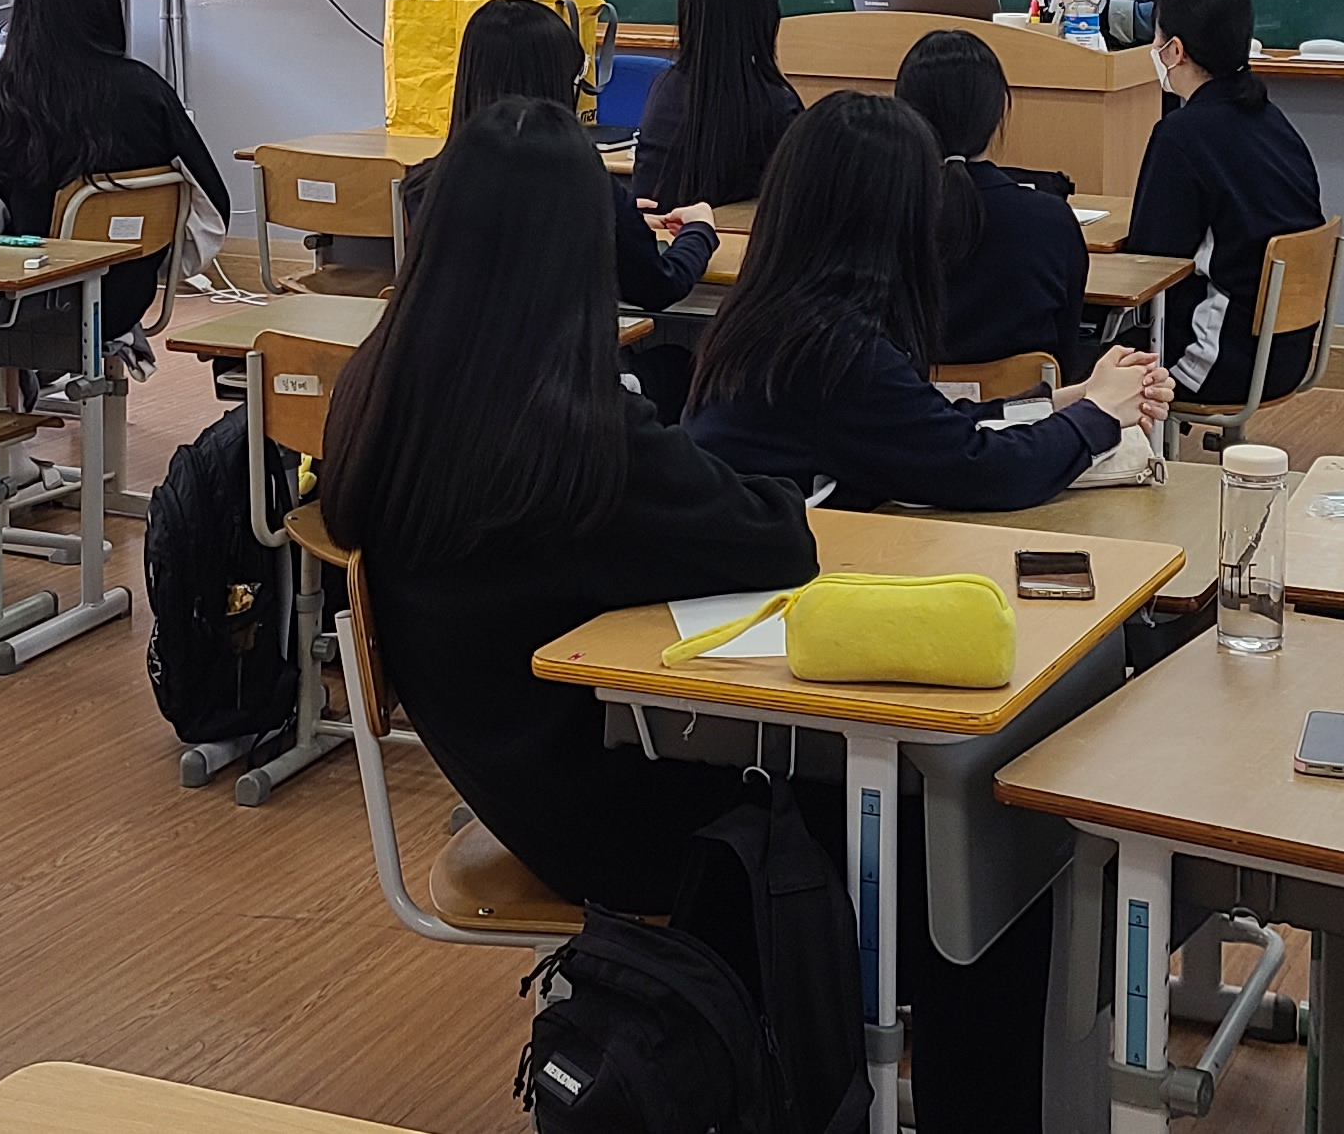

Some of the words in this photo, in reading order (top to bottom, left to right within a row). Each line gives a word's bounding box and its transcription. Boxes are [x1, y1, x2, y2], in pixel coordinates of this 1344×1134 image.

[868, 804, 874, 813] 3
[867, 871, 873, 879] 4
[1136, 915, 1142, 924] 3
[1135, 985, 1141, 993] 4
[1134, 1053, 1140, 1063] 5
